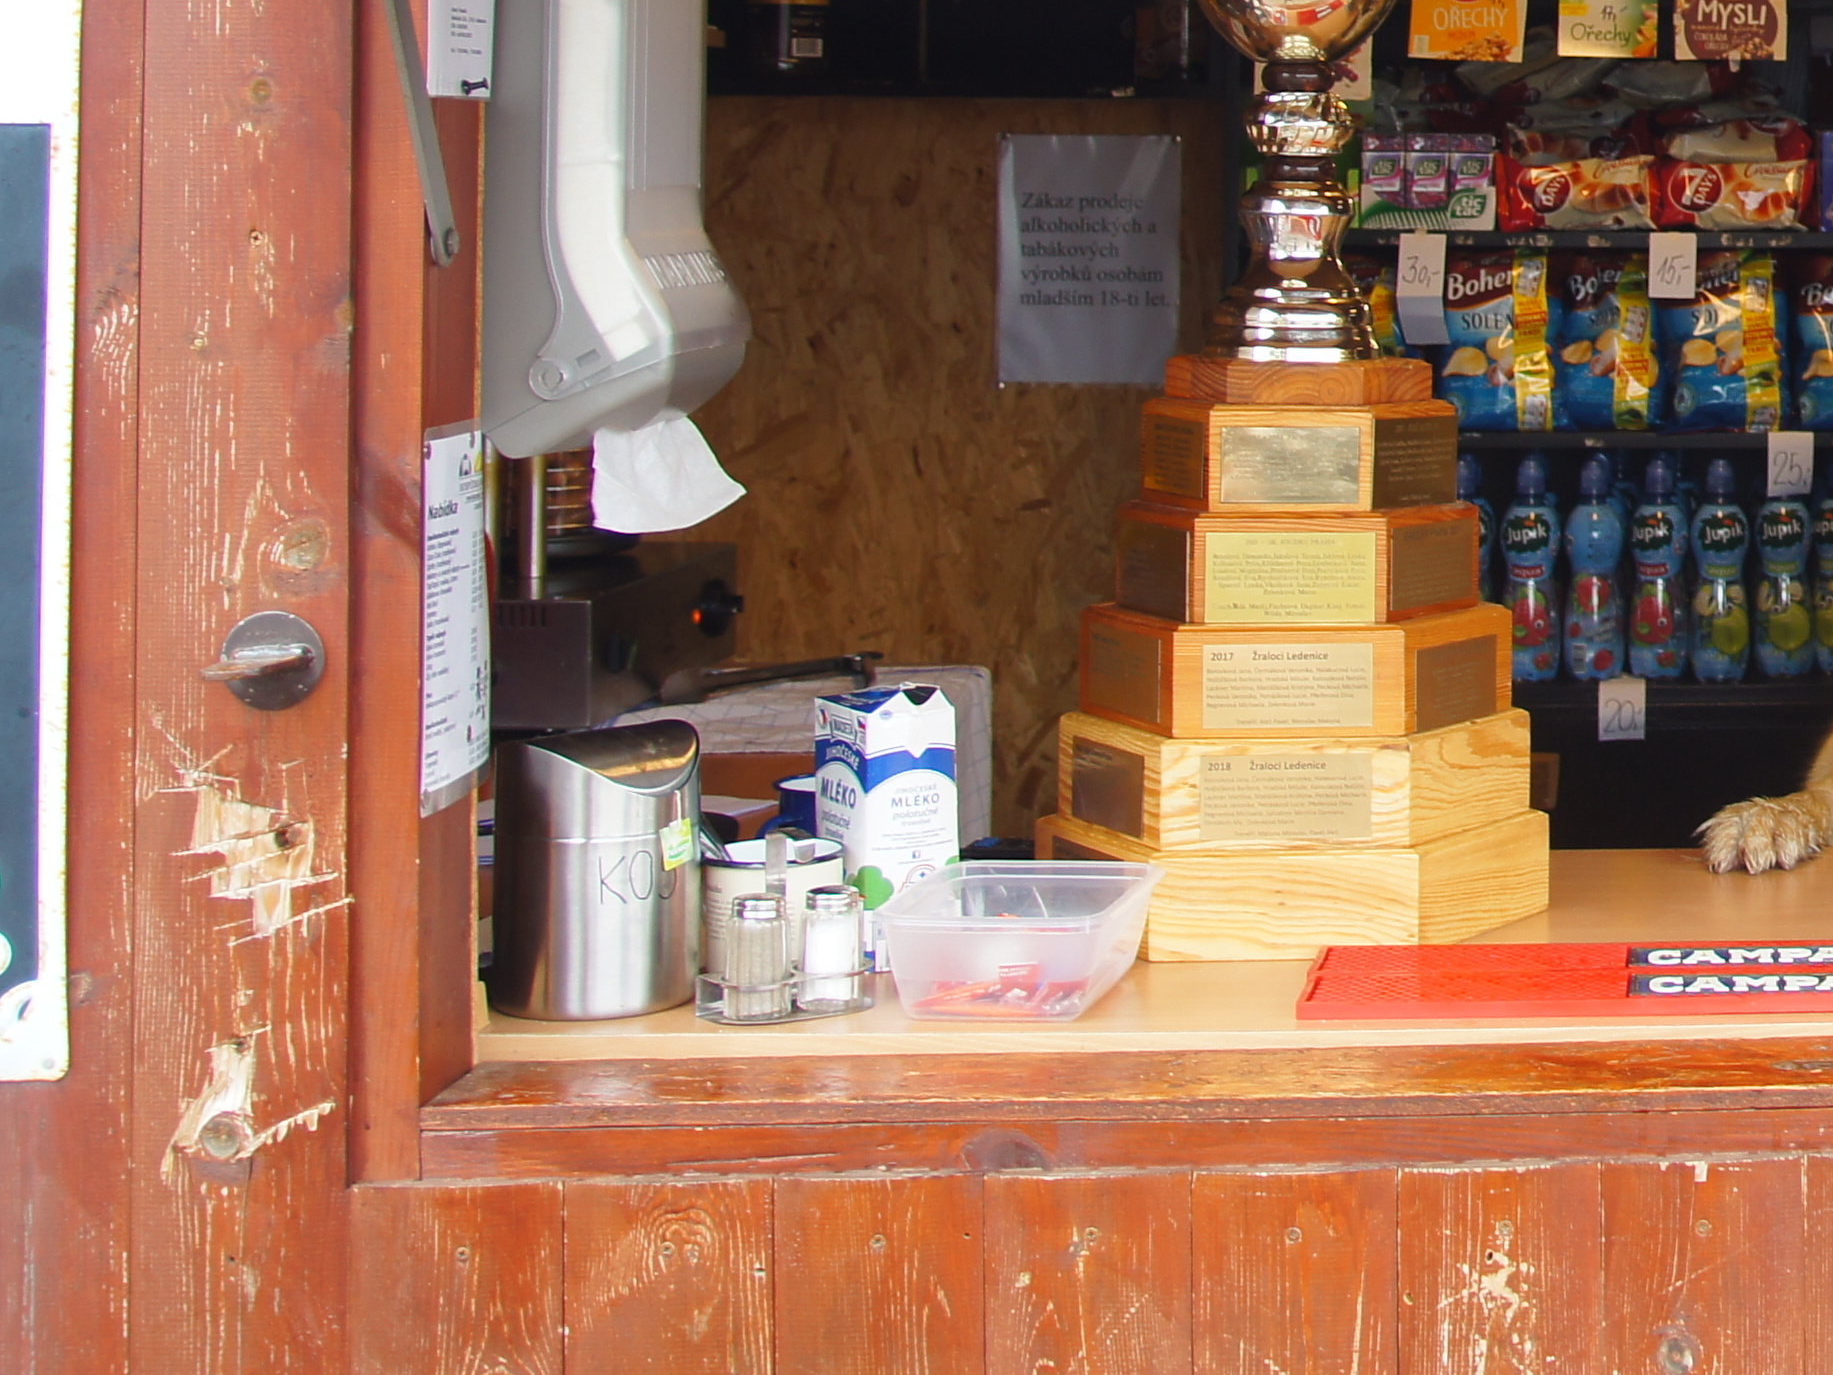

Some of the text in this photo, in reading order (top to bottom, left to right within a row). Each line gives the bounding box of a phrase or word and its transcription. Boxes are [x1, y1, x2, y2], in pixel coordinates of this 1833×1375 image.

[1432, 6, 1509, 30] OŘECHY
[1697, 0, 1768, 30] MYSLI
[1570, 22, 1634, 47] Ořechy
[1681, 167, 1708, 206] 7
[1692, 170, 1717, 205] DAYS
[1021, 192, 1144, 212] Zákaz prodeje
[1461, 194, 1483, 207] tic
[1454, 205, 1481, 218] tac
[1020, 216, 1157, 237] alkoholických a
[1020, 240, 1120, 262] tabákových
[1020, 264, 1164, 285] výrobků osobám
[1020, 289, 1171, 306] mladším 18-ti let.
[1461, 311, 1514, 332] SOLEN
[1210, 650, 1329, 661] 2017 Žraloci Ledenice
[1208, 760, 1327, 771] 2018 Žraloci Ledenice
[820, 776, 857, 810] MLÉKO
[890, 792, 940, 808] MLÉKO
